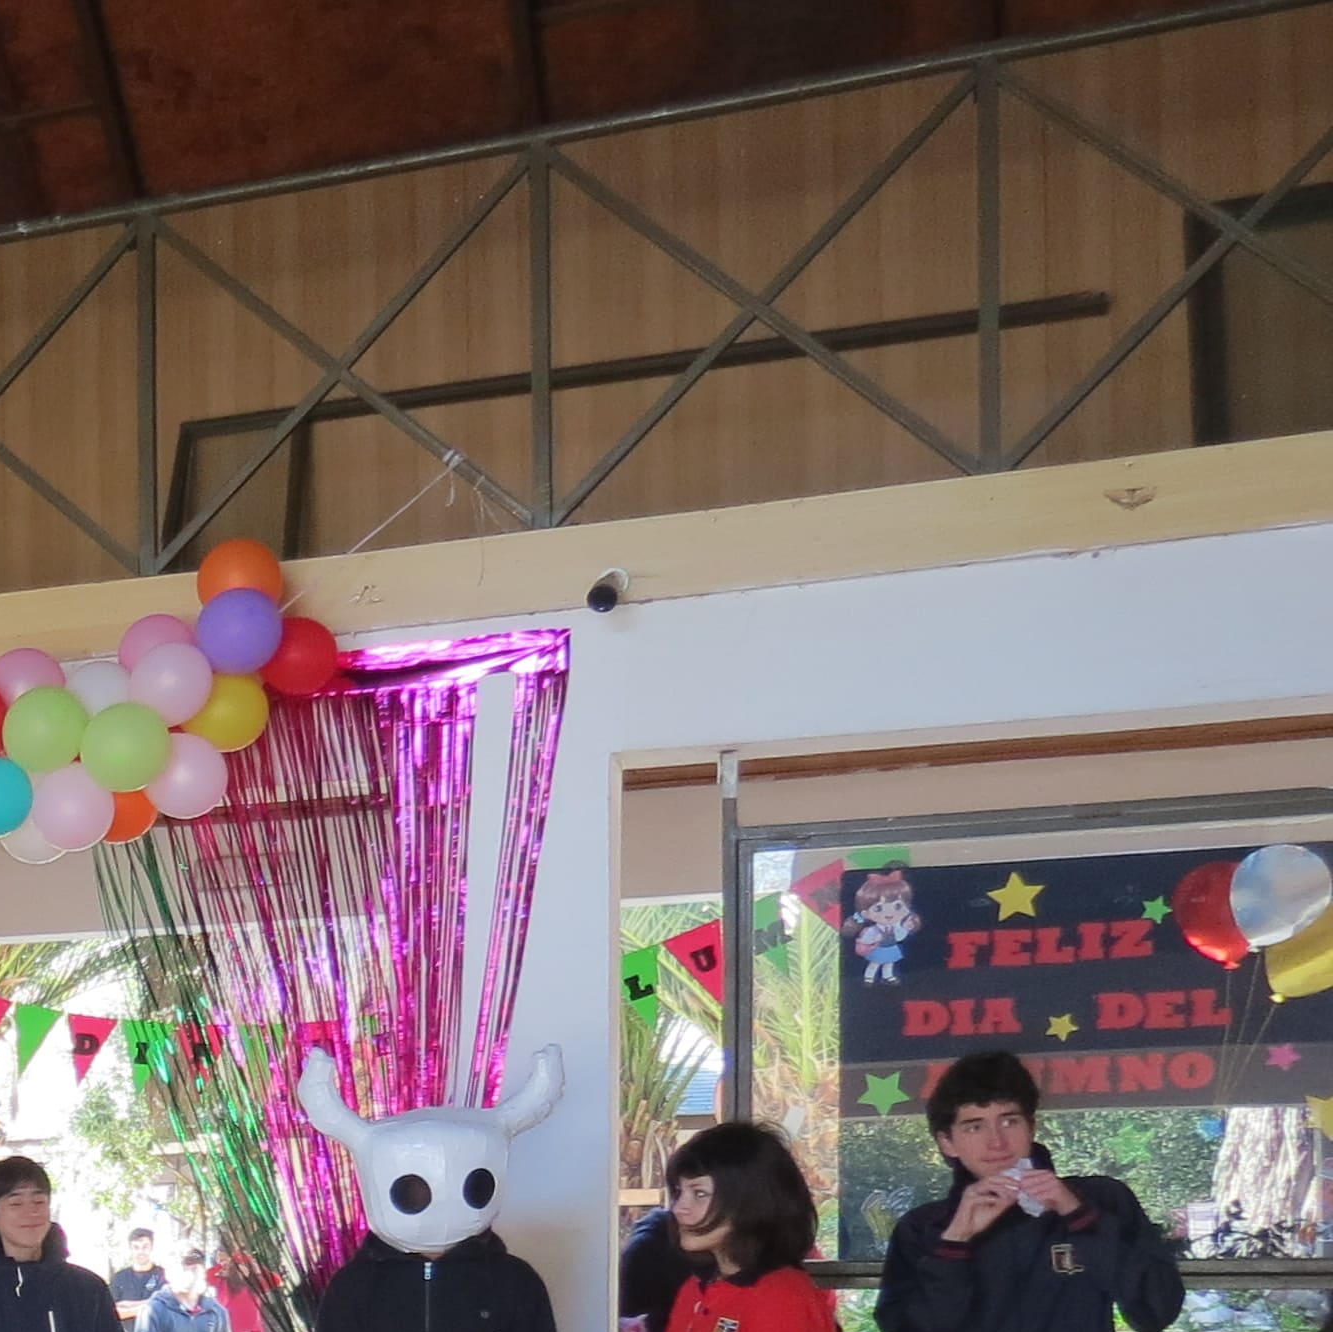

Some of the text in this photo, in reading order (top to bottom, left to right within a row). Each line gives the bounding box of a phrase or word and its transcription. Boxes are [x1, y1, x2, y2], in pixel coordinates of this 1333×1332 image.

[947, 918, 1156, 970] FELIZ
[902, 988, 1232, 1037] DIA DEL
